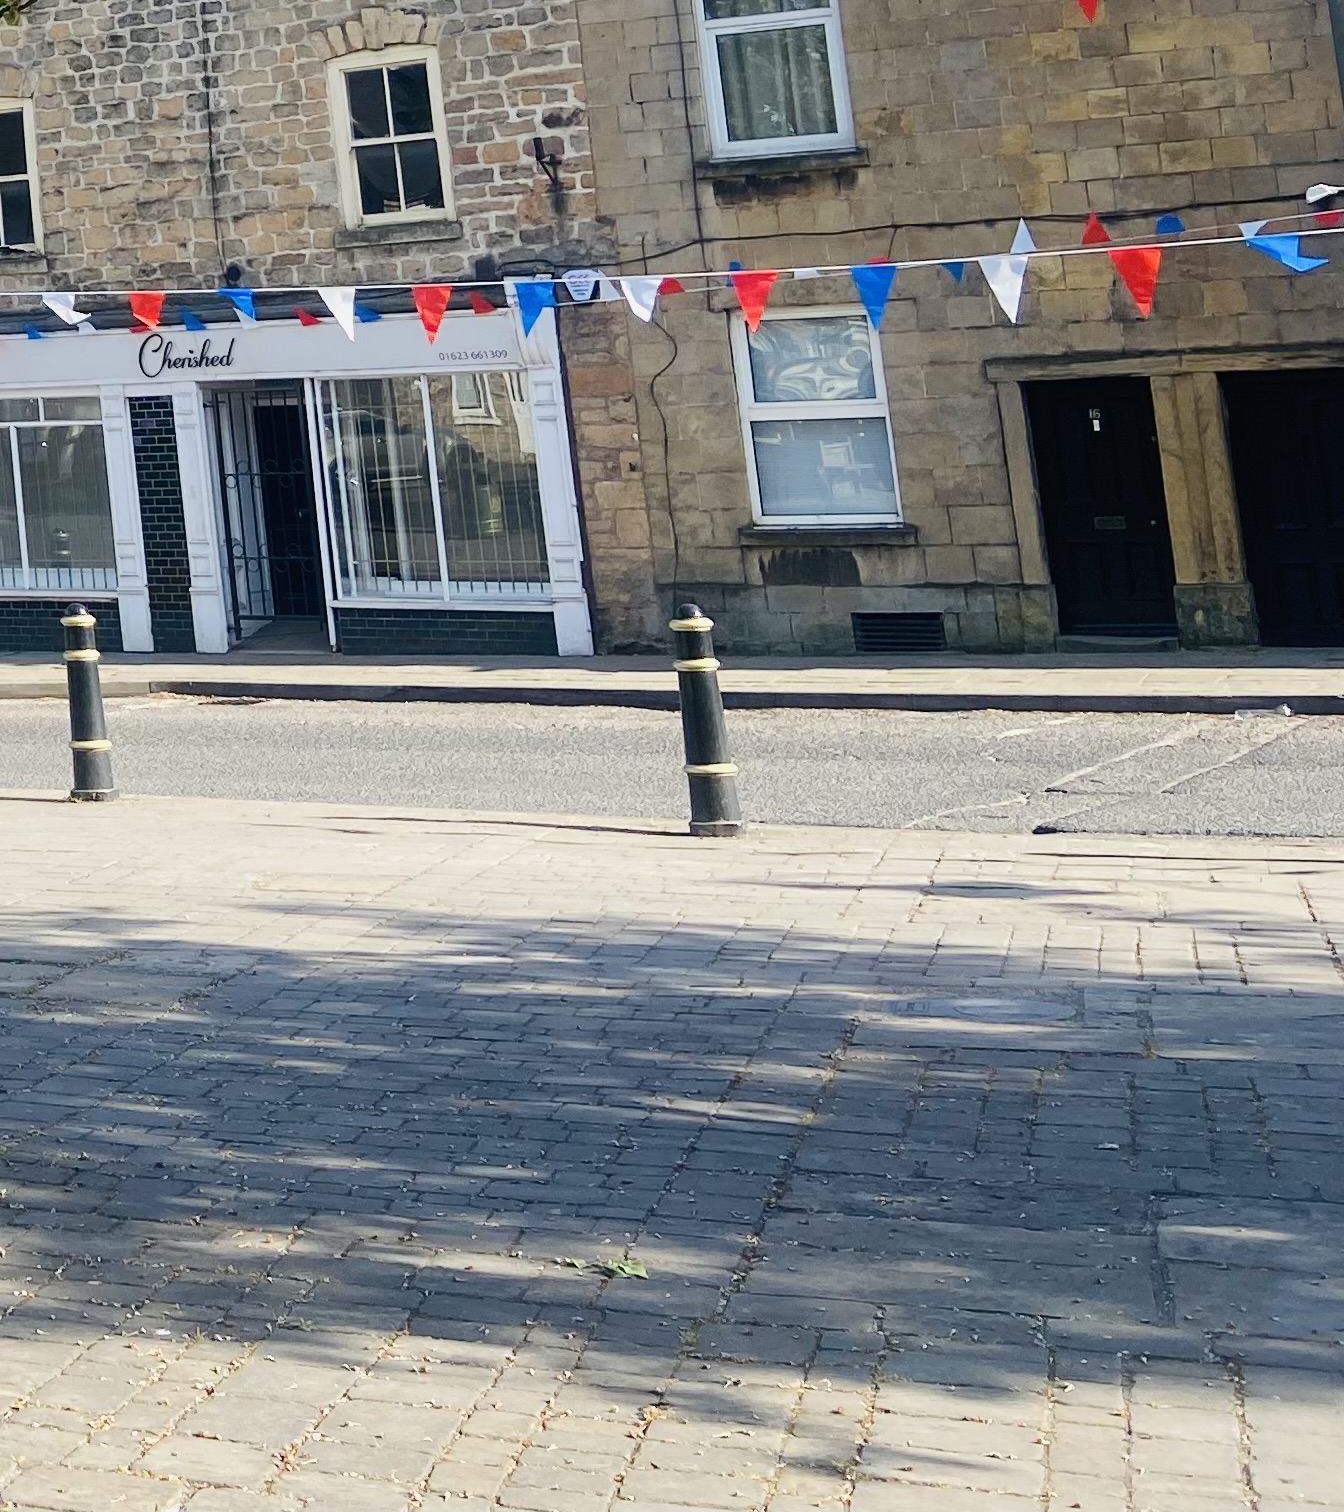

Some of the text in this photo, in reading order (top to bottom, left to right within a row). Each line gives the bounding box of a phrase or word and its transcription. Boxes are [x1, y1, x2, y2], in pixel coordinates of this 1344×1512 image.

[138, 333, 235, 378] Cherished
[438, 349, 508, 361] 01623 661309
